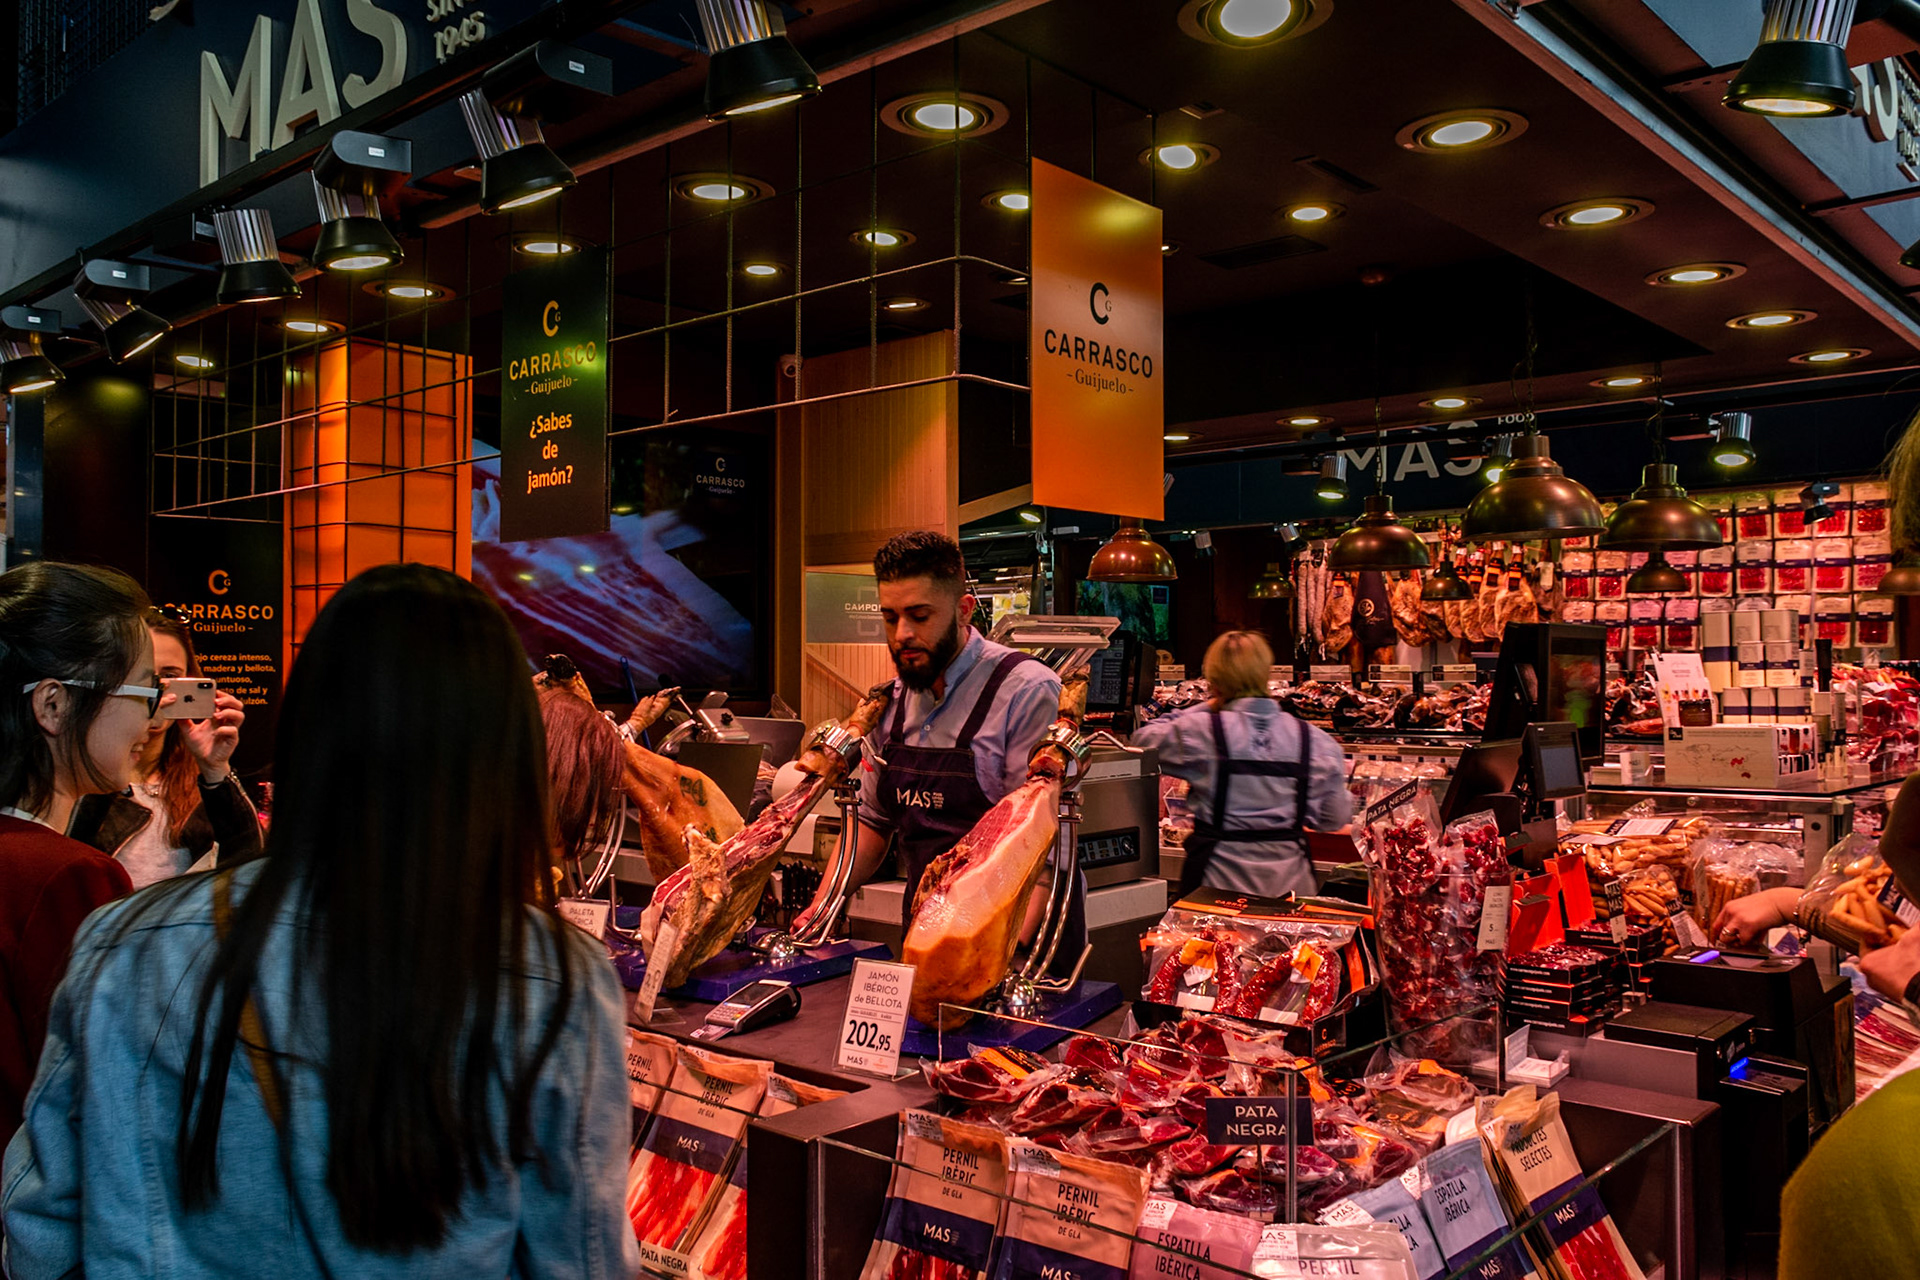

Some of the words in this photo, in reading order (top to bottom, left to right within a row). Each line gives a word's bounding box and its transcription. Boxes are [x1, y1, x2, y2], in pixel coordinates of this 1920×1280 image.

[200, 0, 407, 188] MAS
[509, 341, 597, 381] CARRASCO
[1044, 329, 1153, 378] CARRASCO
[529, 412, 573, 439] ¿Sabes
[542, 440, 558, 460] de
[1335, 420, 1483, 484] MAS
[526, 465, 574, 494] jamón?
[696, 474, 745, 488] CARRASCO
[165, 603, 274, 620] RRASCO
[195, 652, 208, 662] ojo
[209, 654, 237, 662] cereza
[238, 653, 272, 662] intenso,
[203, 664, 236, 673] madera
[237, 666, 243, 674] y
[244, 664, 276, 673] bellota,
[236, 686, 247, 694] de
[248, 686, 261, 694] sal
[262, 687, 268, 695] y
[896, 787, 931, 809] MAS
[1367, 804, 1387, 821] PATA
[1388, 786, 1416, 809] NEGRA
[569, 907, 594, 916] PALETA
[867, 971, 899, 983] JAMÓN
[863, 982, 898, 996] IBÉRICO
[854, 994, 864, 1003] de
[865, 995, 902, 1009] BELLOTA
[628, 1053, 653, 1071] PERNIL
[846, 1055, 863, 1065] MAS
[704, 1076, 734, 1095] PERNIL
[908, 1113, 932, 1123] MAS
[1235, 1105, 1279, 1118] PATA
[1226, 1123, 1287, 1136] NEGRA
[676, 1136, 699, 1152] MAS
[943, 1147, 979, 1169] PERNIL
[1520, 1145, 1553, 1172] SELECTES
[942, 1187, 950, 1196] DE
[951, 1188, 963, 1199] GLA
[1057, 1183, 1100, 1208] PERNIL
[1434, 1178, 1468, 1205] ESPATLLA
[1444, 1198, 1472, 1223] IBÈRICA
[1554, 1204, 1576, 1225] MAS
[923, 1222, 951, 1243] MAS
[1057, 1226, 1066, 1235] DE
[1068, 1229, 1081, 1240] GLA
[1157, 1232, 1211, 1261] ESPATLLA
[641, 1250, 660, 1264] PATA
[661, 1255, 688, 1273] NEGRA
[1155, 1255, 1200, 1280] IBÈRICA
[1298, 1260, 1360, 1275] PERNIL
[1478, 1258, 1500, 1280] MAS
[1041, 1265, 1072, 1280] MAS
